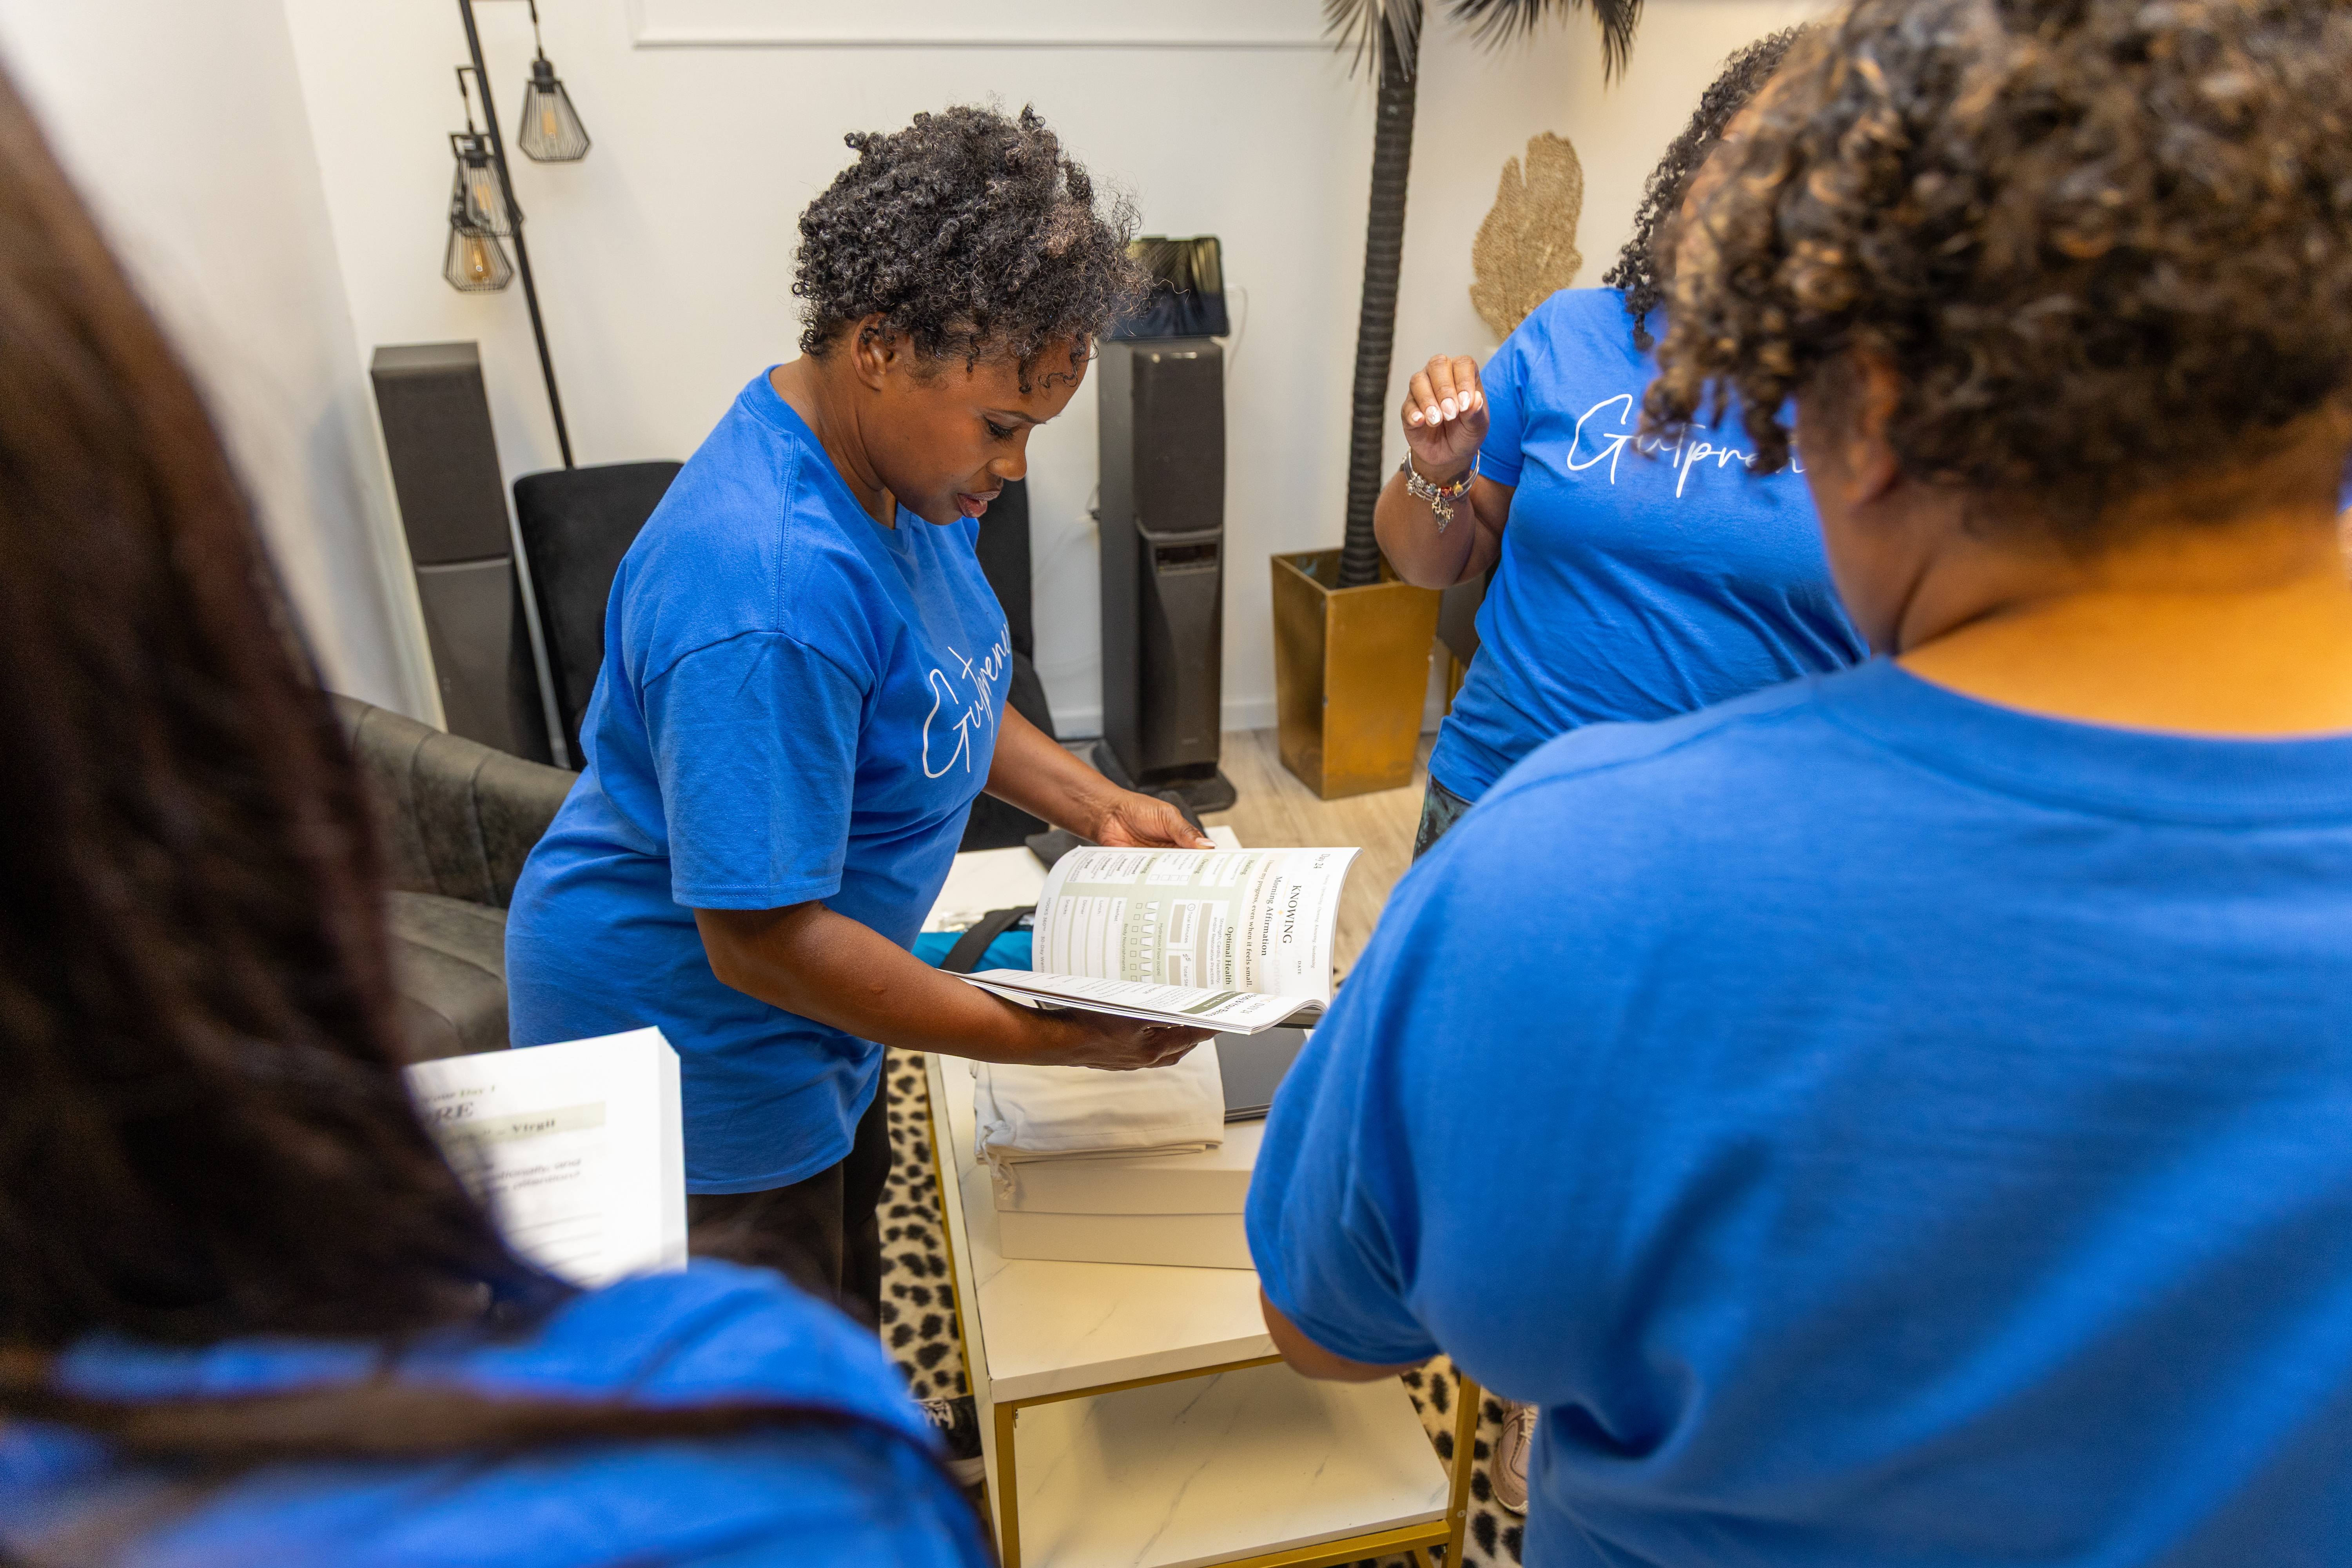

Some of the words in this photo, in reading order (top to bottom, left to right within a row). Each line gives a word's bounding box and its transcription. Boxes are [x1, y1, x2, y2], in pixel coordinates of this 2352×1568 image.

[1140, 857, 1157, 874] Knowing
[1194, 859, 1209, 874] Owning
[1315, 854, 1330, 862] Day
[1240, 860, 1255, 875] Healing
[1265, 862, 1274, 872] honor
[1252, 880, 1263, 904] progress,
[1266, 876, 1283, 904] Morning
[1283, 885, 1302, 944] KNOWING
[1261, 906, 1274, 956] Affirmation
[1225, 927, 1234, 958] Optimal
[512, 1119, 555, 1134] Virgil
